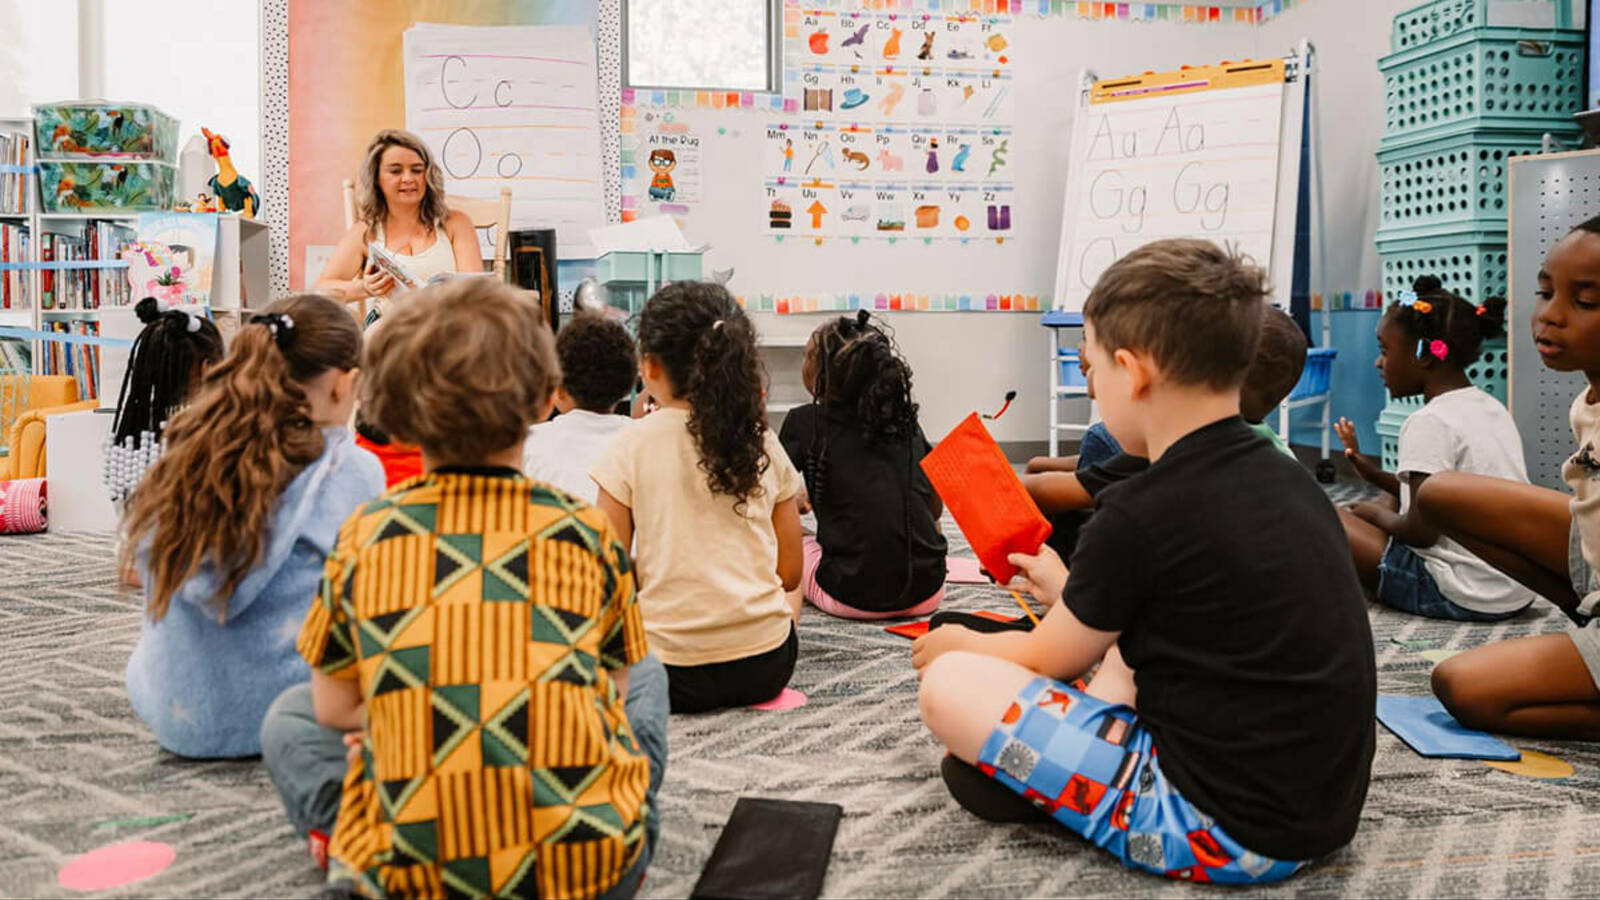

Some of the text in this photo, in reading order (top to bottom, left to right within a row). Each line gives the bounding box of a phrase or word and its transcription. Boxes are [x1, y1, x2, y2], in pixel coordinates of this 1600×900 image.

[804, 17, 819, 27] Aa
[876, 20, 890, 30] Cc
[912, 20, 926, 30] Dd
[804, 73, 819, 85] Gg
[840, 75, 855, 85] Hh
[947, 77, 960, 88] Kk
[767, 130, 786, 140] Mm
[803, 131, 818, 141] Nn
[840, 133, 855, 143] Oo
[876, 134, 890, 146] Pp
[1153, 106, 1205, 155] Aa
[649, 135, 660, 145] At
[661, 135, 678, 145] the
[766, 187, 777, 198] Tt
[802, 189, 817, 199] Uu
[840, 191, 854, 201] Vv
[876, 191, 895, 202] Ww
[947, 191, 961, 204] Yy
[983, 192, 996, 202] Zz
[1089, 160, 1230, 234] Gg Gg
